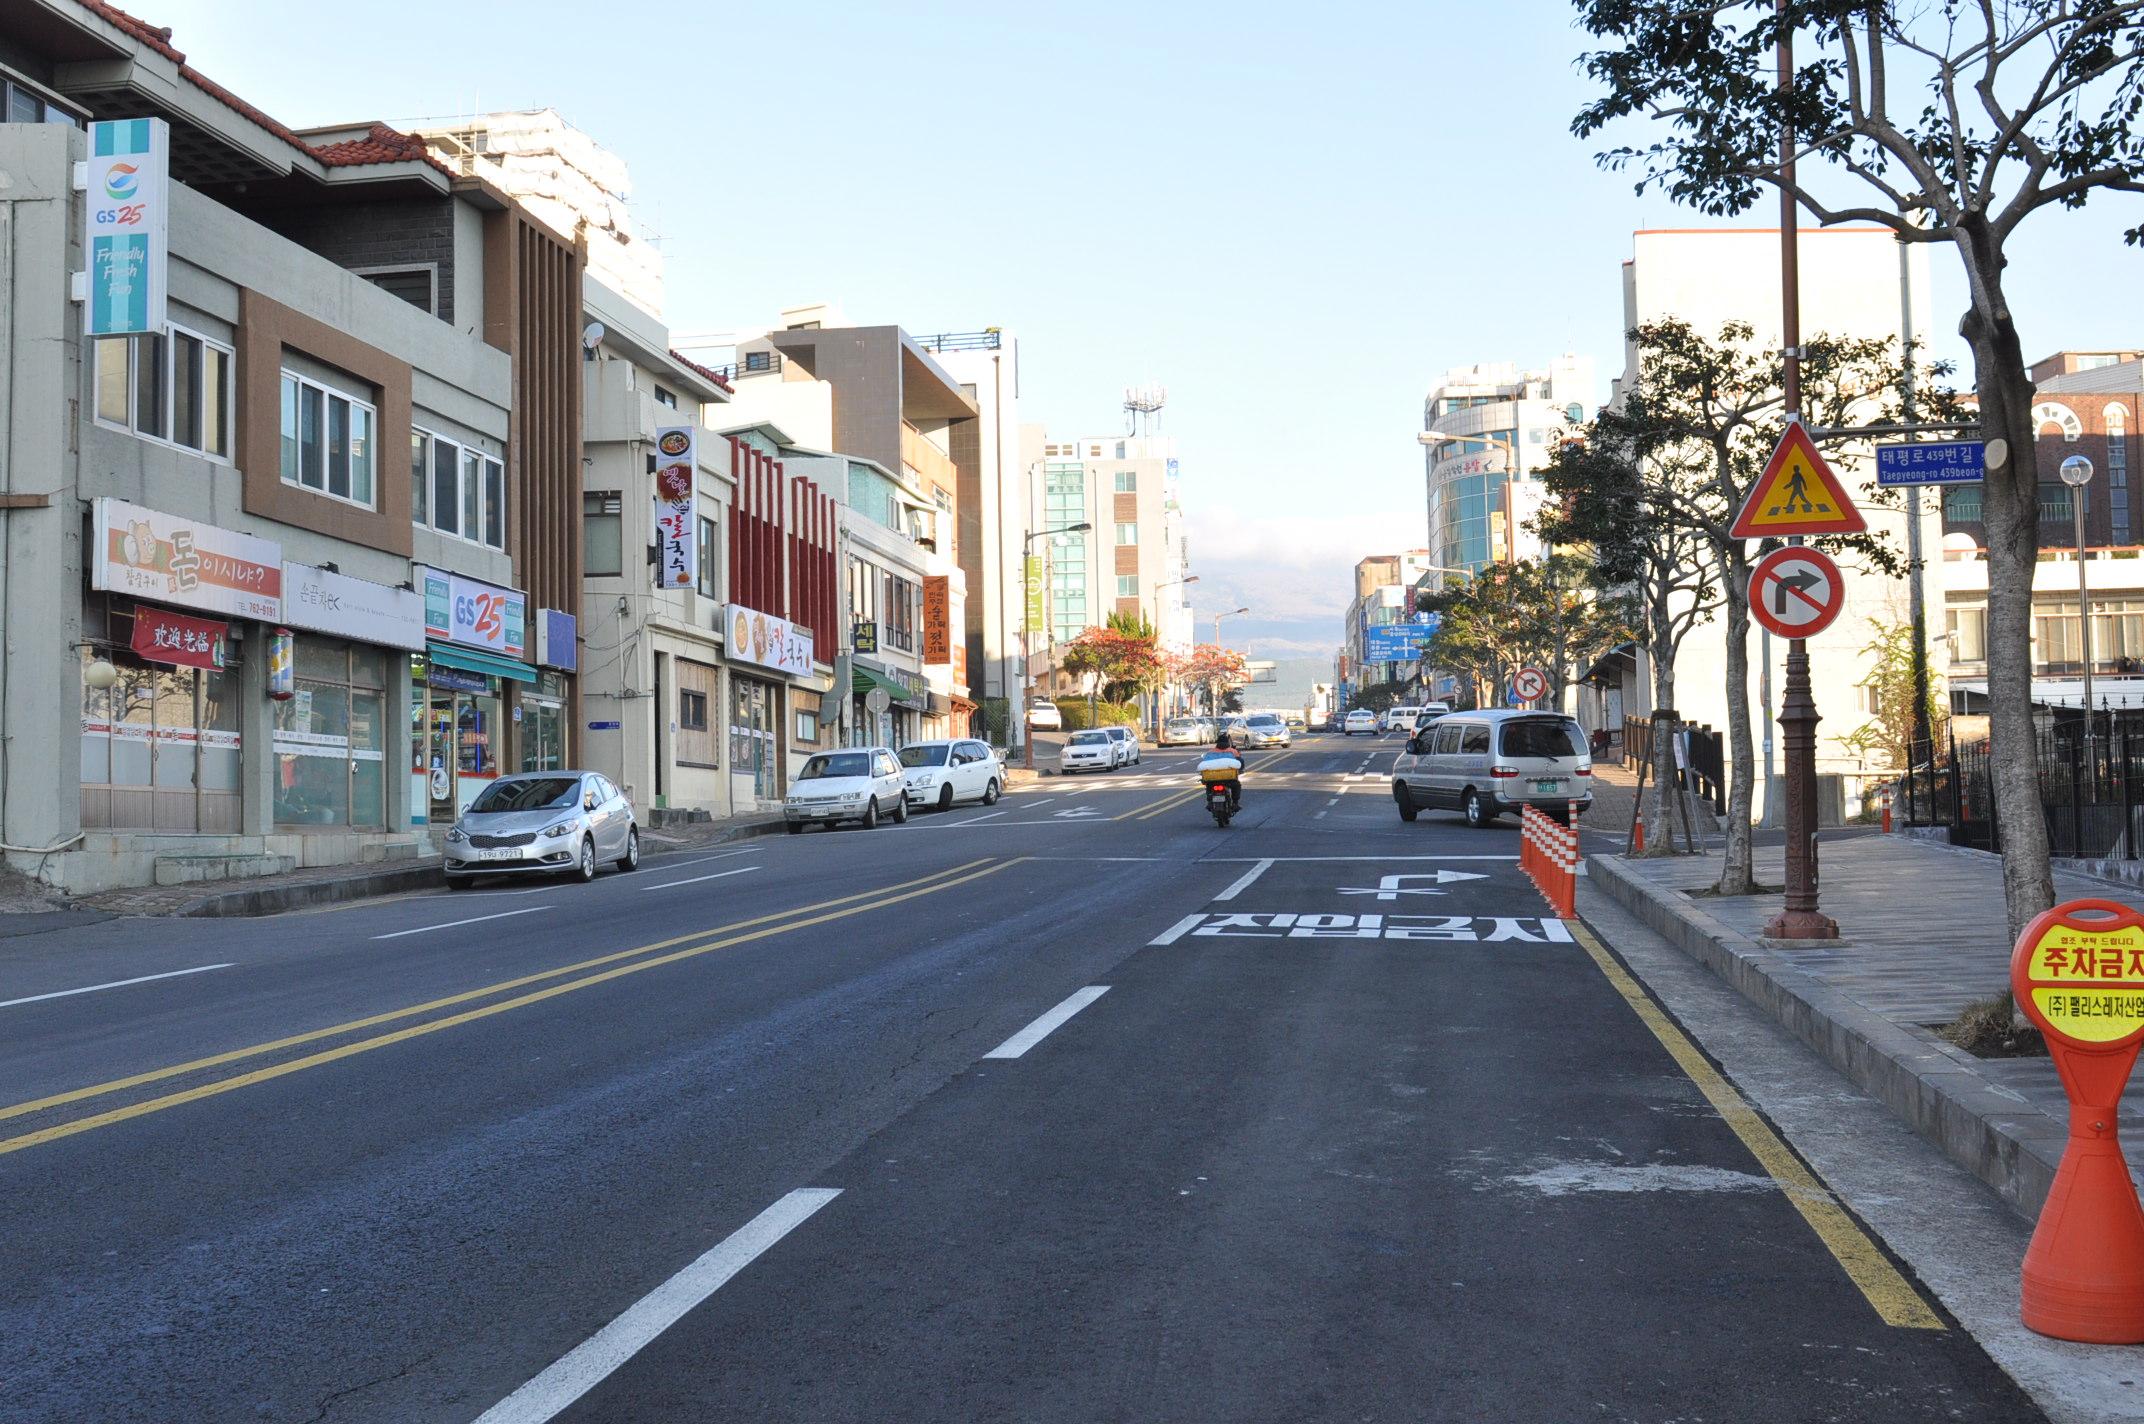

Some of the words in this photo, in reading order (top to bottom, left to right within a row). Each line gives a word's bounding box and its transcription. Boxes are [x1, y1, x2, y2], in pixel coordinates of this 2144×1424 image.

[96, 204, 146, 225] GS25
[96, 248, 145, 264] Friendly
[104, 265, 138, 280] Fresh
[108, 283, 133, 297] Fun
[1882, 447, 1972, 466] 태평로439번길
[1882, 470, 1938, 481] Taepyeong-ro
[660, 515, 691, 572] 칼국수
[455, 593, 504, 641] GS25
[856, 624, 875, 651] 세탁
[1191, 913, 1575, 943] 진입금지
[2081, 936, 2098, 945] 부탁
